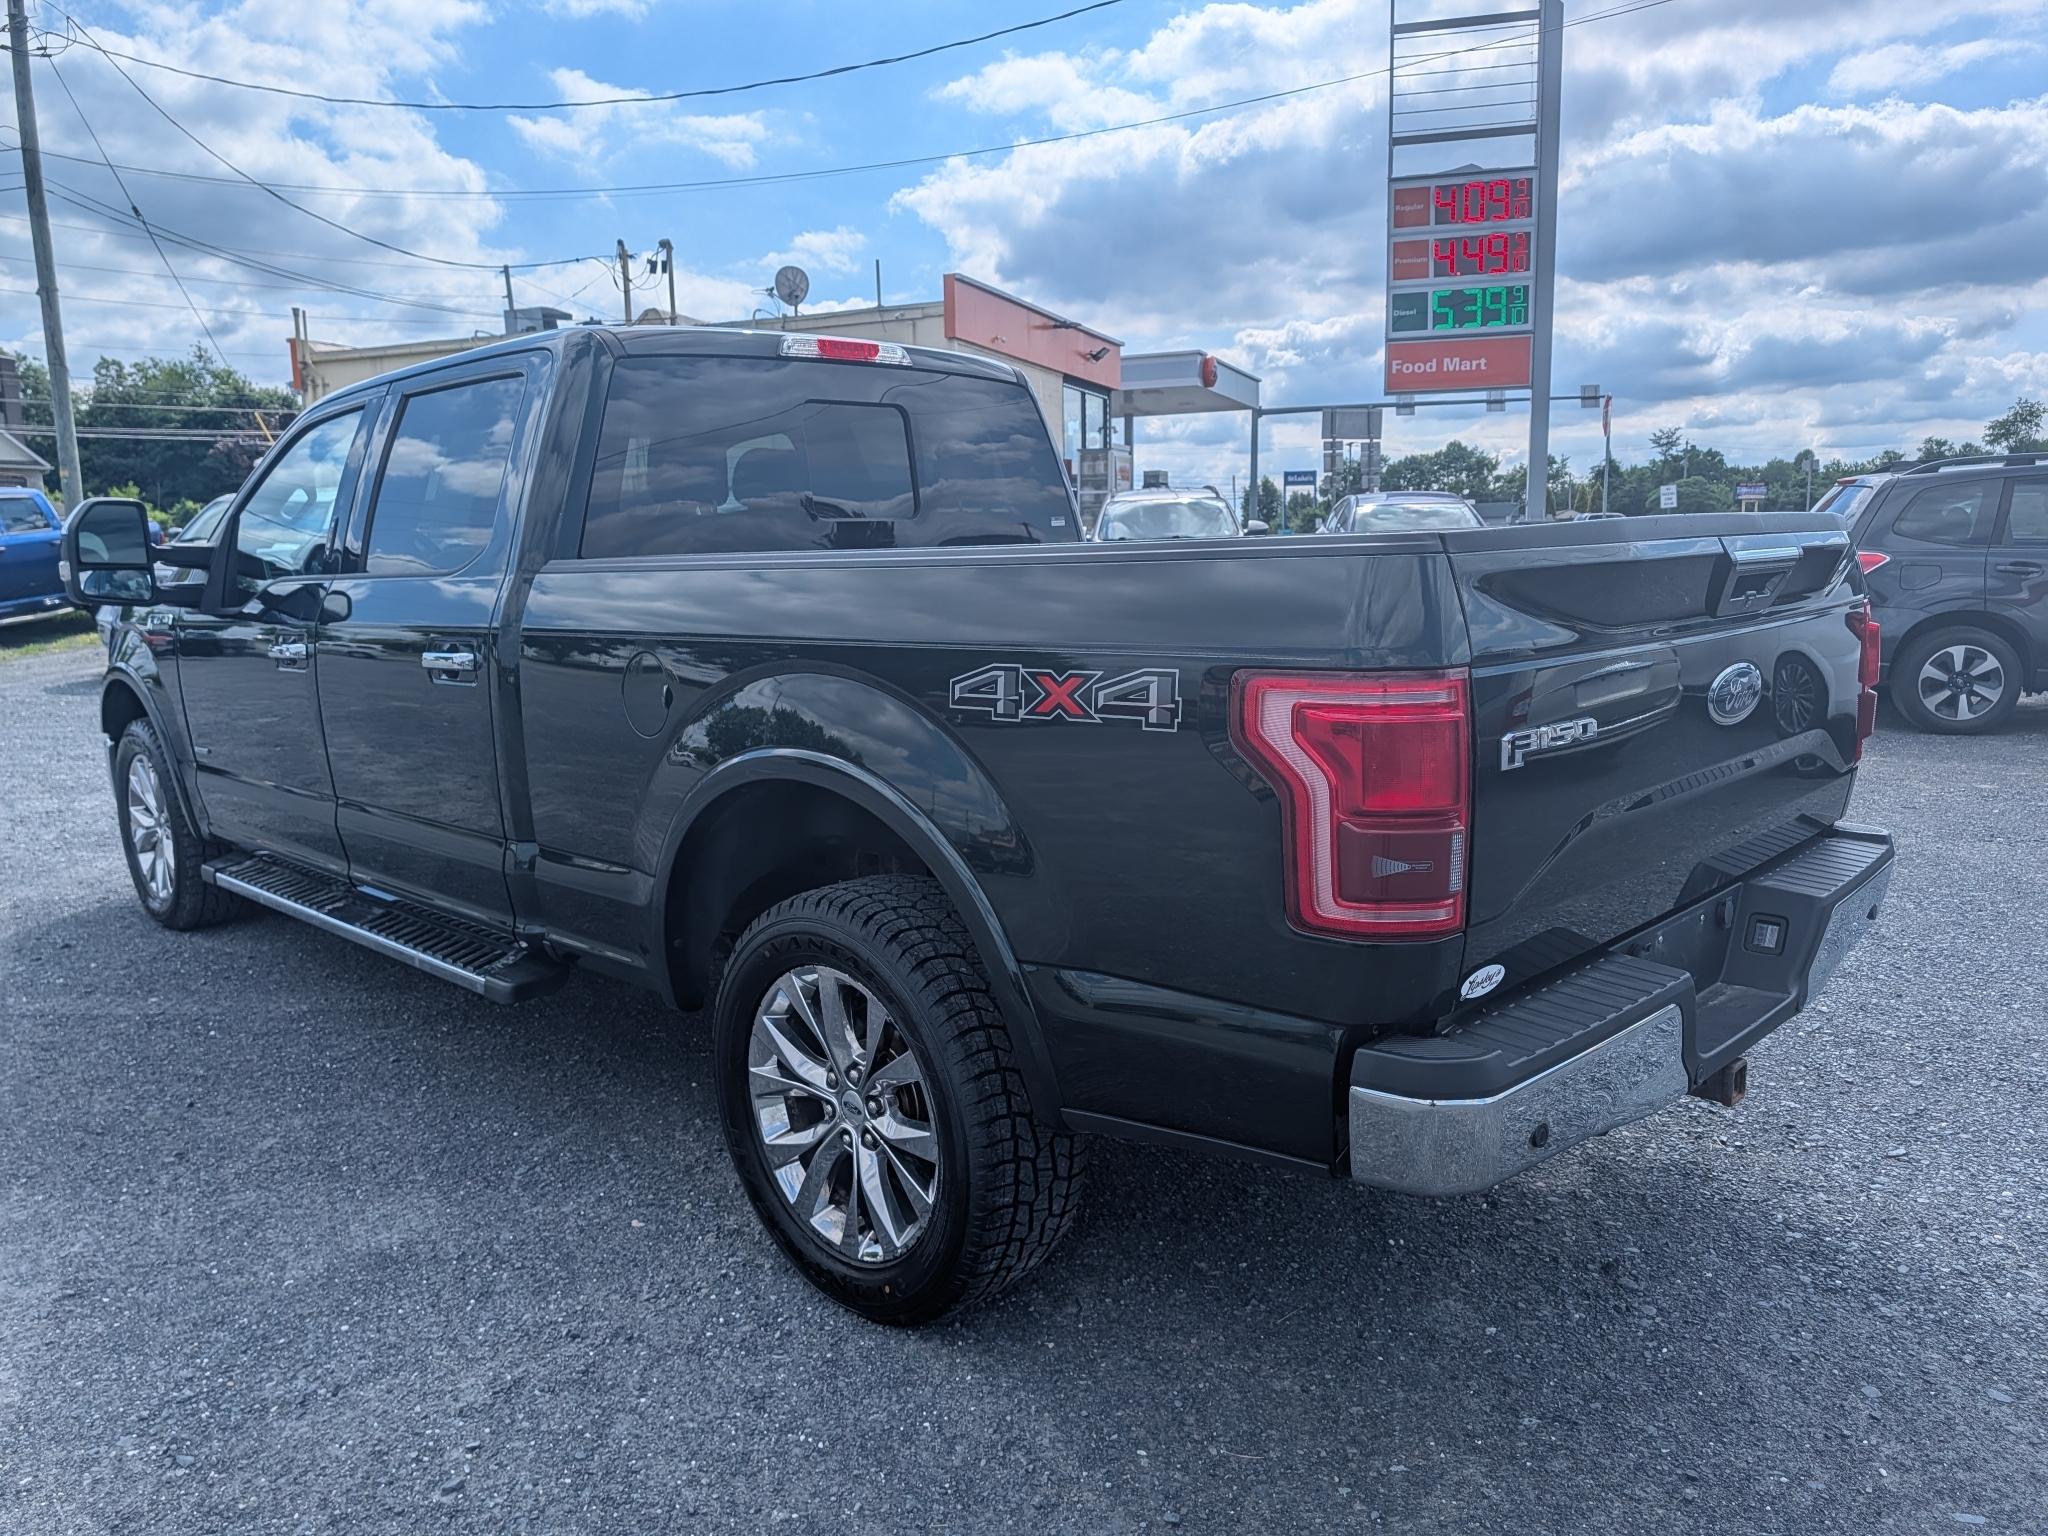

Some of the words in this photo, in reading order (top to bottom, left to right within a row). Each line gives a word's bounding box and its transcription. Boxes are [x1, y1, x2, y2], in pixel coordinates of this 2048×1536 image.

[1395, 204, 1424, 213] Regular
[1395, 257, 1428, 265] Premium
[1393, 308, 1417, 317] Diesel
[1391, 358, 1437, 374] Food
[1443, 357, 1488, 372] Mart
[1726, 677, 1756, 711] Ford
